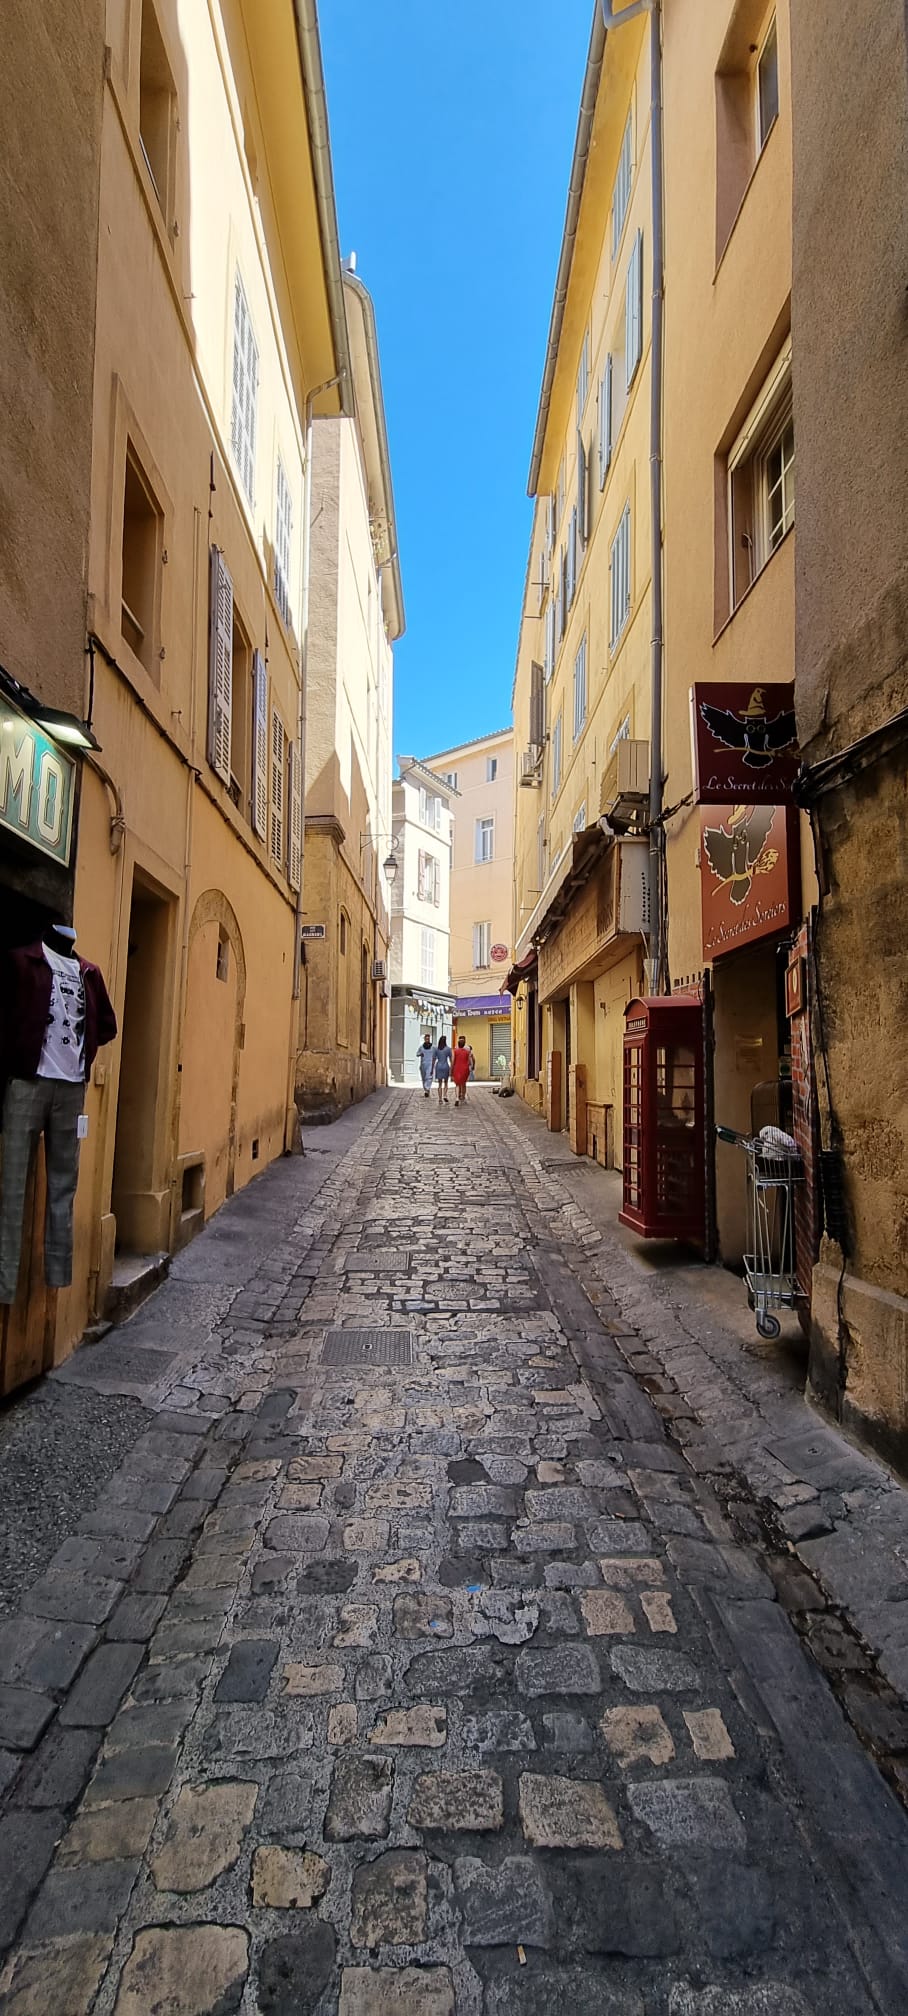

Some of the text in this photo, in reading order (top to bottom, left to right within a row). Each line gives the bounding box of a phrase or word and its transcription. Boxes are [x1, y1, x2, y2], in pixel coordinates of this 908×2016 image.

[703, 775, 721, 790] Le
[723, 775, 757, 790] Secret
[717, 921, 739, 943] Secret
[752, 901, 786, 926] Sorciers
